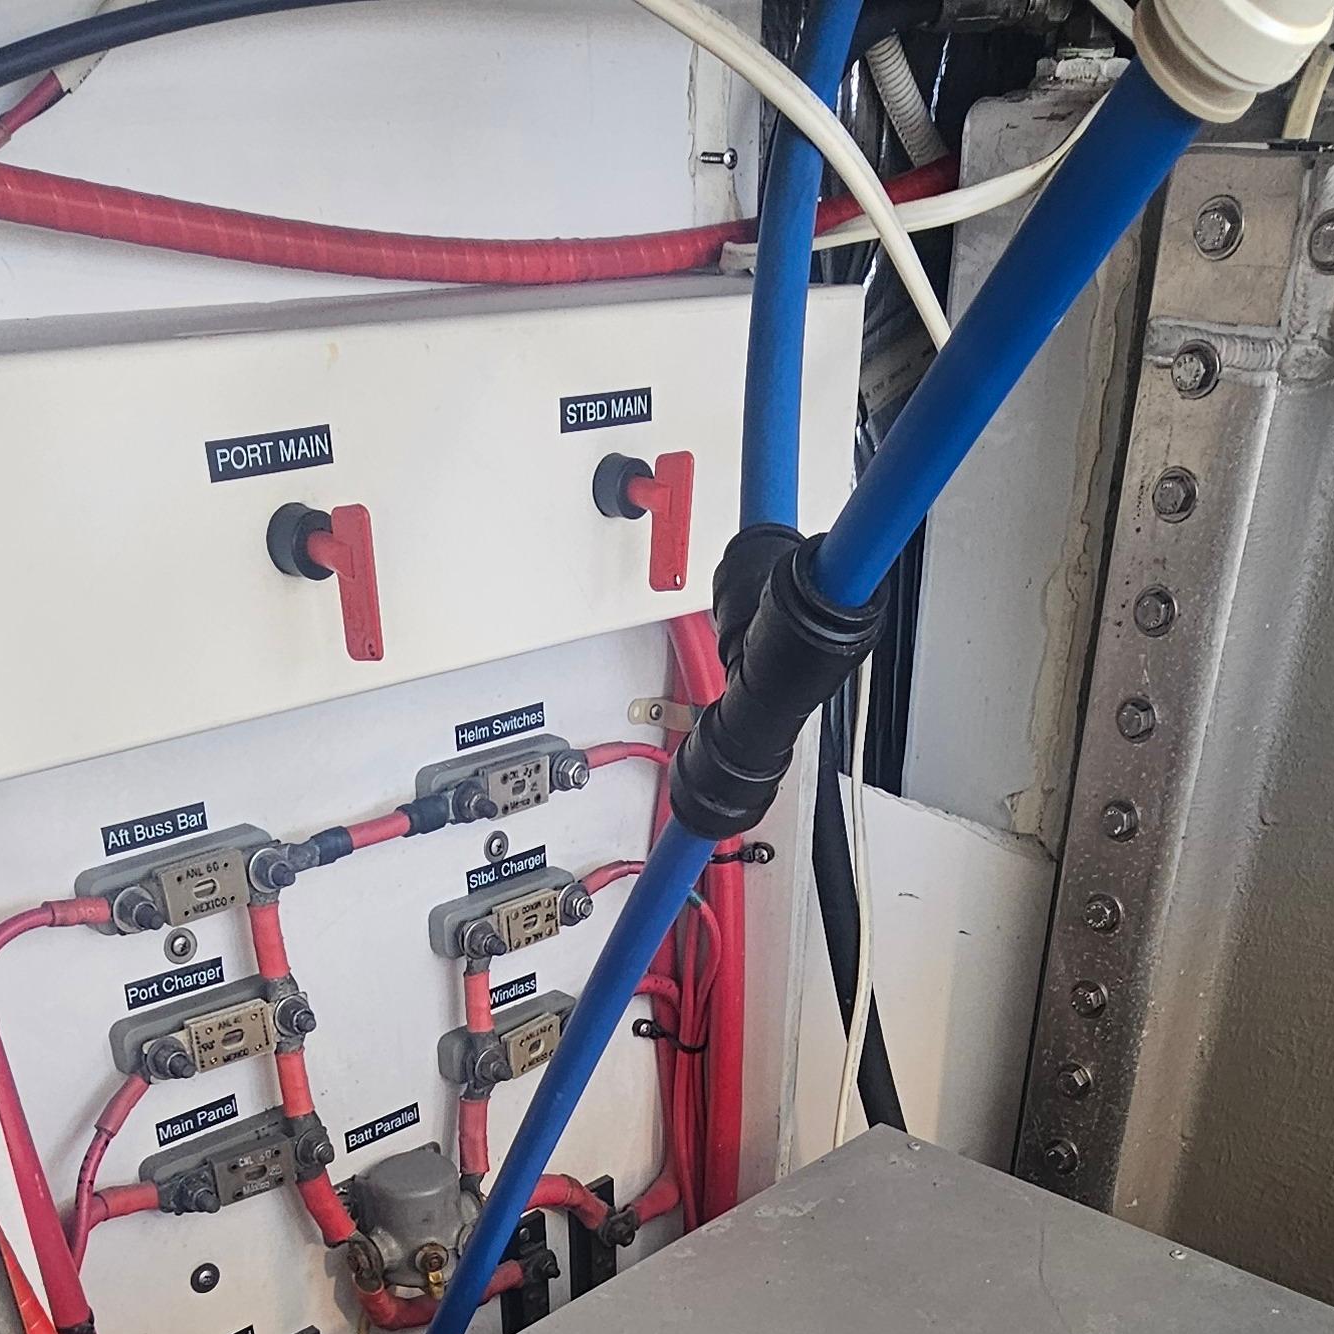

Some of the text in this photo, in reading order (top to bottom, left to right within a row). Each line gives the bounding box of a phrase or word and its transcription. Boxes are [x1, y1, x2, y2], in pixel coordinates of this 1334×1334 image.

[566, 394, 648, 425] STBD MAIN
[216, 433, 330, 472] PORT MAIN
[459, 710, 544, 745] Helm Switches
[107, 812, 205, 849] Aft Buss Bar
[185, 866, 204, 880] ANL
[469, 852, 546, 889] Stbd. Charger
[192, 896, 228, 915] MEXICO
[127, 965, 222, 1004] Port Charger
[489, 978, 536, 1005] Windlass
[158, 1100, 237, 1142] Main Panel
[348, 1107, 418, 1148] Batt Parallel
